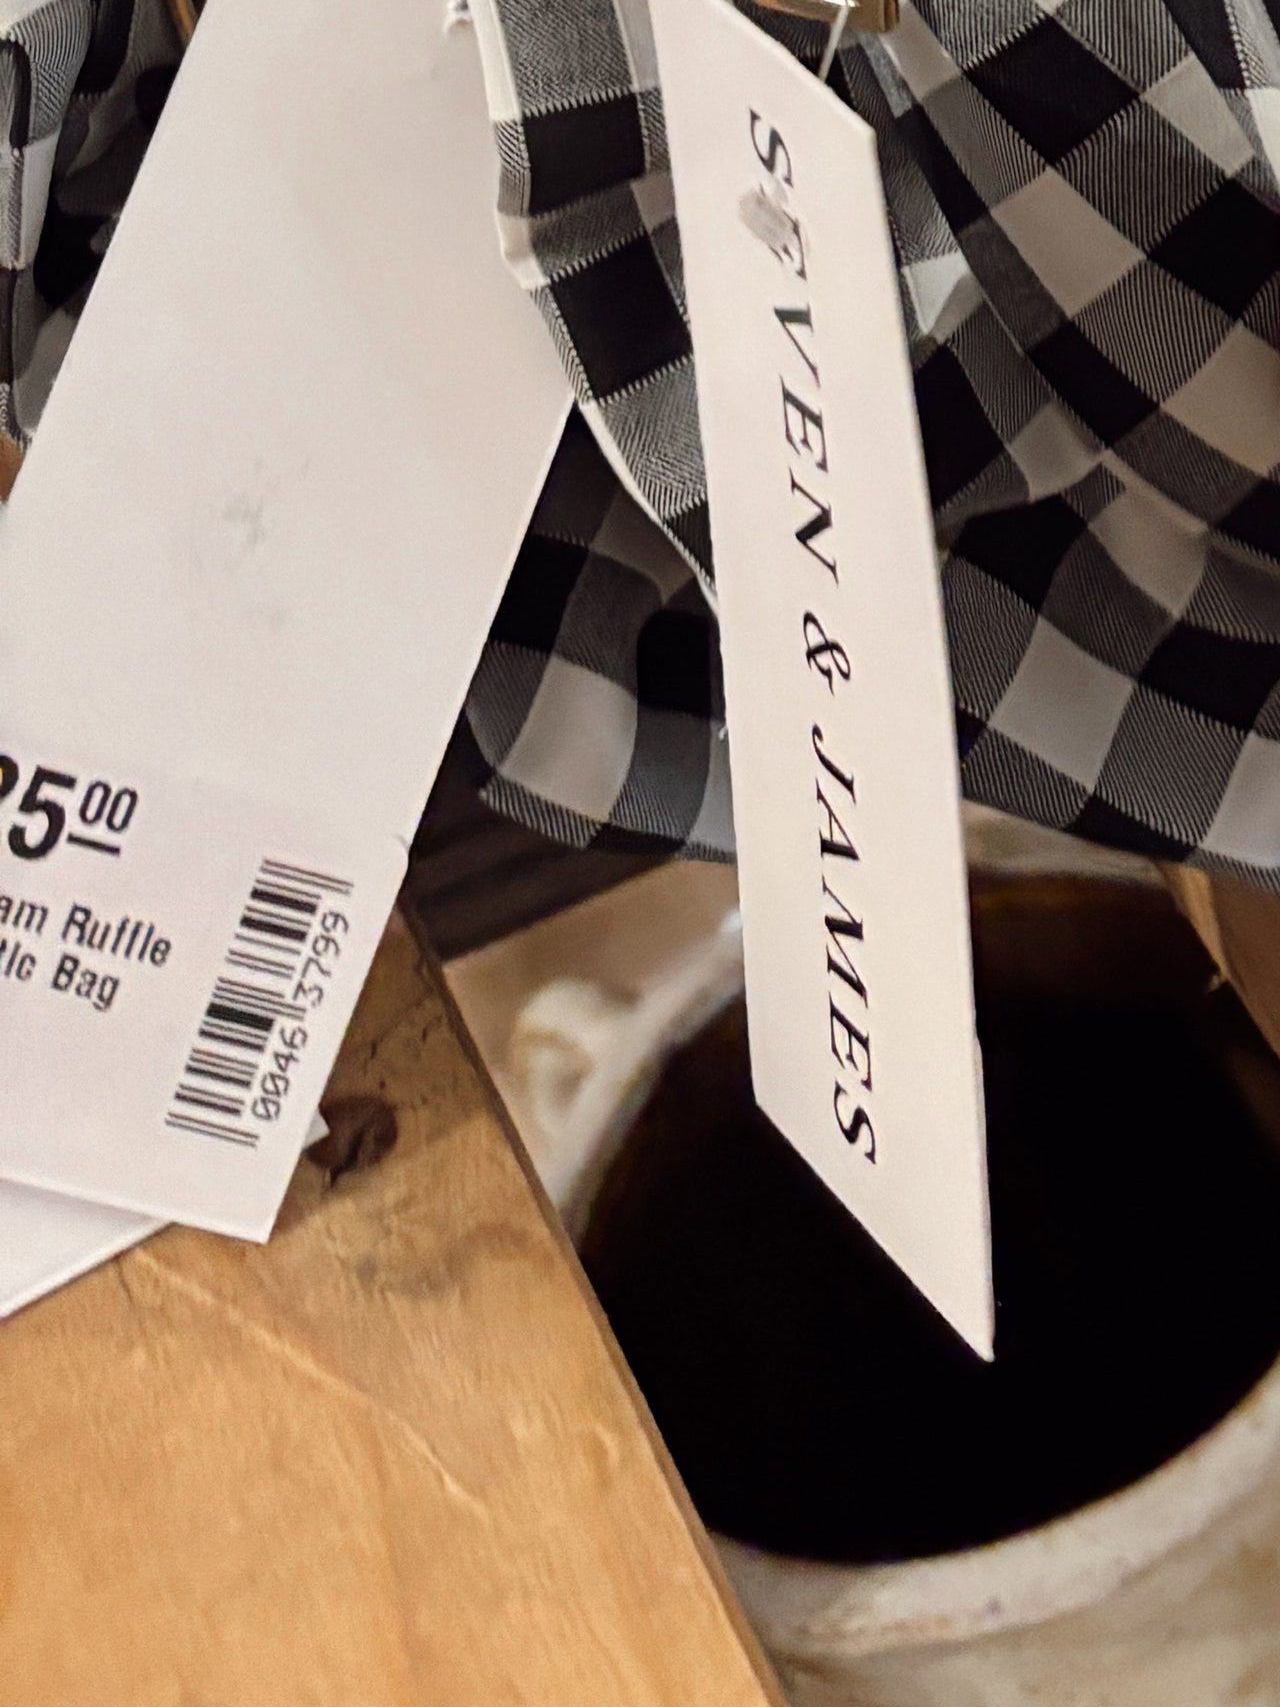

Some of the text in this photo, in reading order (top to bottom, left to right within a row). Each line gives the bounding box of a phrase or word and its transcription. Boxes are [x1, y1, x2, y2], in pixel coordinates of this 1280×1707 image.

[802, 610, 852, 696] &
[61, 902, 171, 967] Ruffle
[811, 722, 876, 1166] JAMES
[51, 951, 120, 1012] Bag
